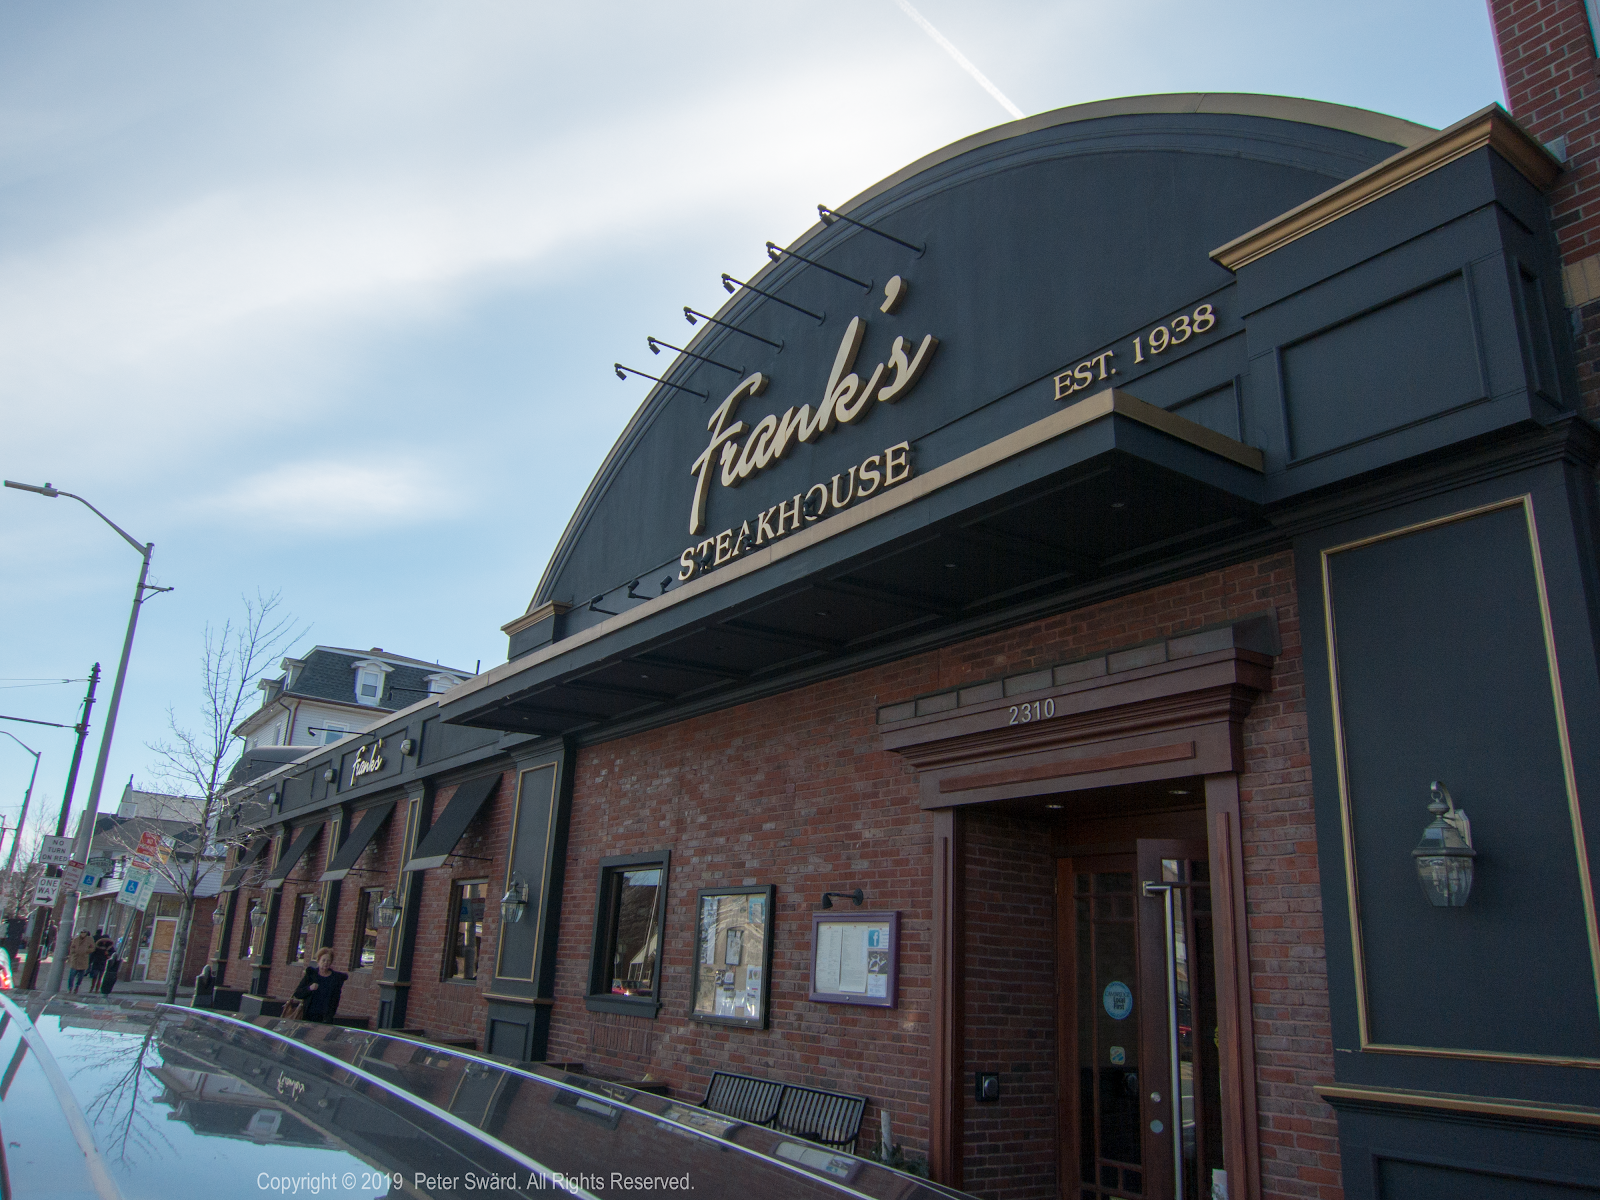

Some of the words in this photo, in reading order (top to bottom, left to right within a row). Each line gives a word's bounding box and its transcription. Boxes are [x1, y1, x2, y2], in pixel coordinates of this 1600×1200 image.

[1053, 350, 1117, 401] EST.
[1132, 303, 1216, 364] 1938
[689, 275, 936, 535] Frank's
[677, 440, 912, 581] STEAKHOUSE
[1009, 698, 1055, 725] 2310
[42, 853, 53, 861] ON
[54, 854, 68, 862] RED
[48, 846, 67, 854] TURN
[37, 886, 58, 895] WAY
[40, 879, 59, 888] ONE
